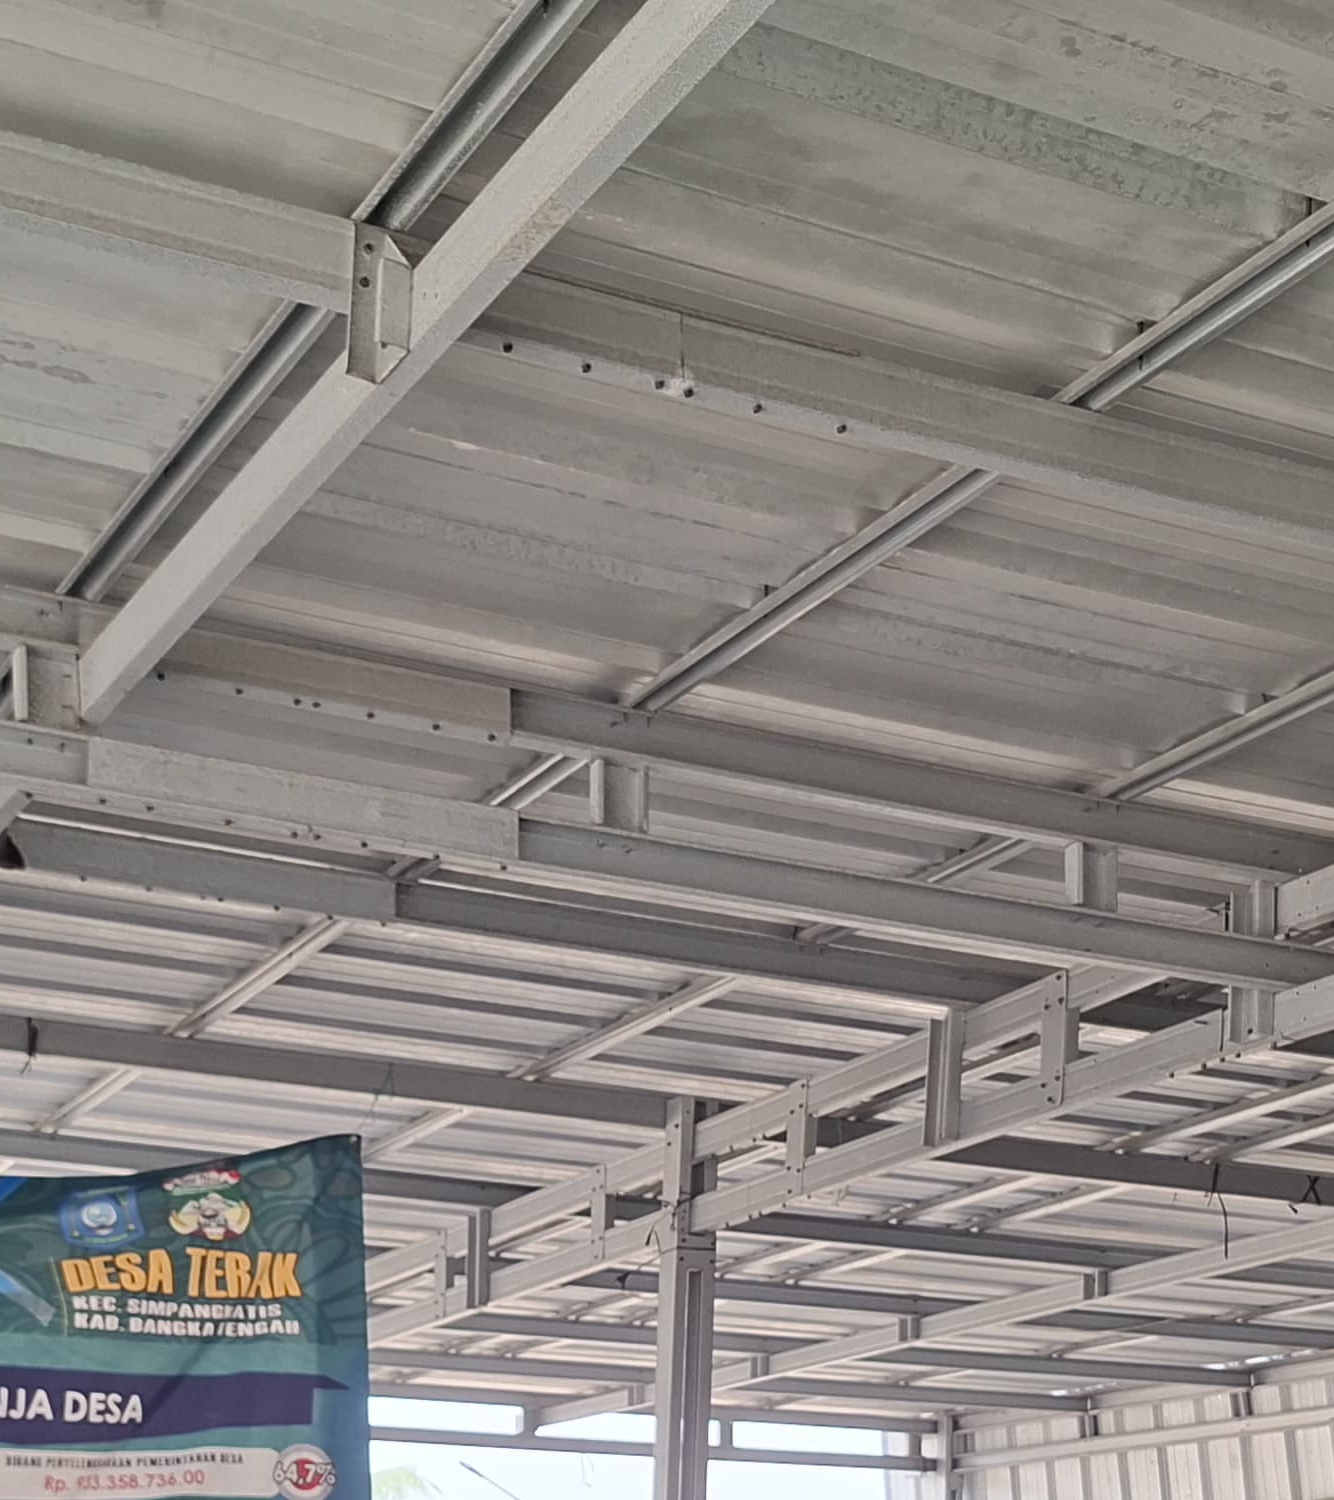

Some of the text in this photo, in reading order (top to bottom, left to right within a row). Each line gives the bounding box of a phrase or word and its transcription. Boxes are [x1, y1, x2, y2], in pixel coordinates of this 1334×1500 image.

[62, 1247, 302, 1299] DESA TERAK
[73, 1297, 122, 1314] KEC.
[63, 1391, 144, 1424] DESA
[44, 1474, 69, 1494] Rp.
[273, 1460, 336, 1485] 64,7%
